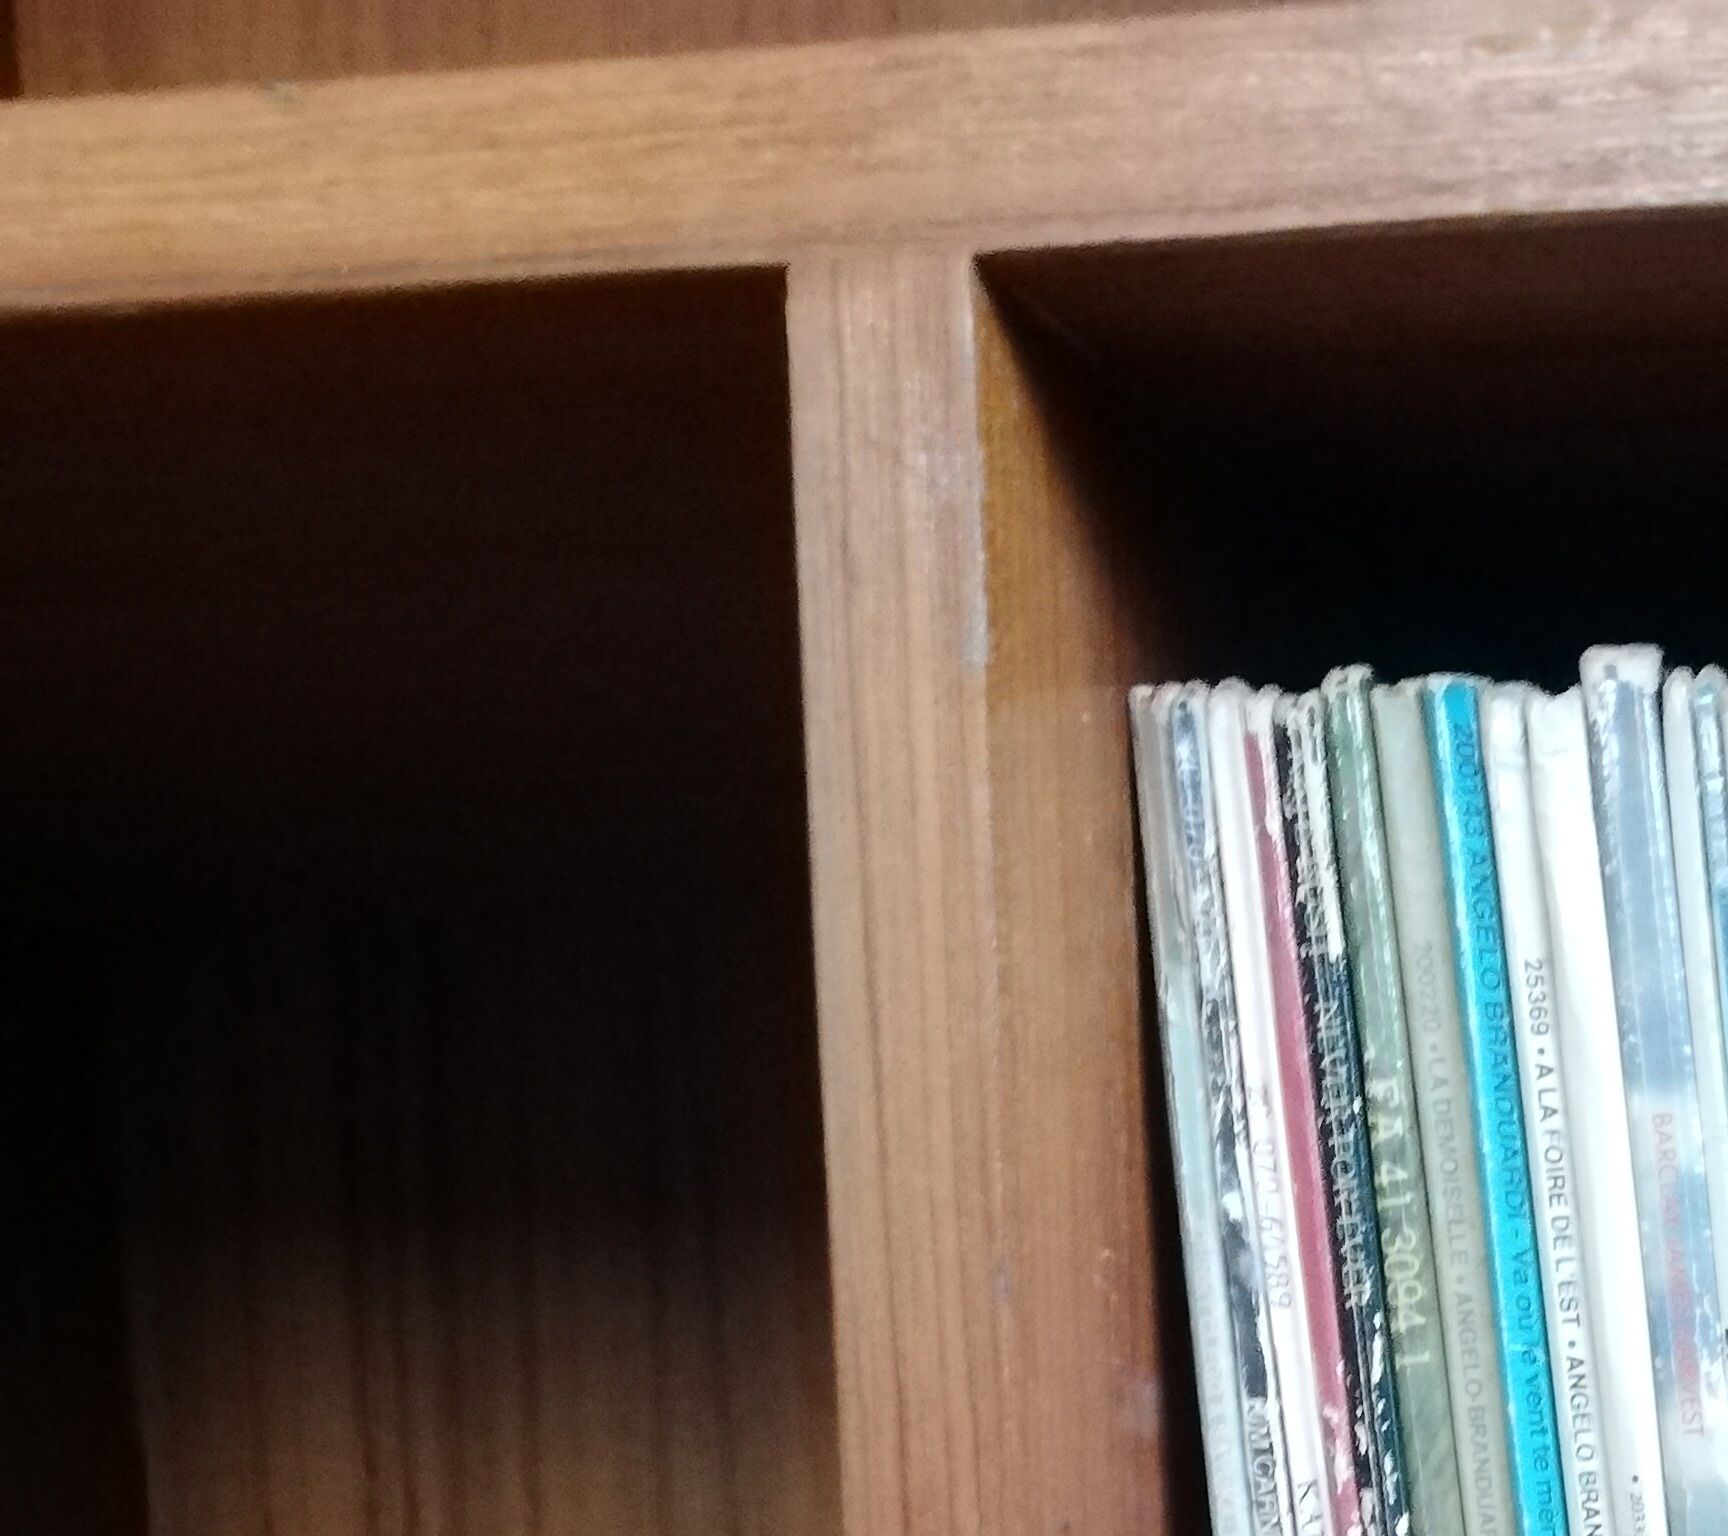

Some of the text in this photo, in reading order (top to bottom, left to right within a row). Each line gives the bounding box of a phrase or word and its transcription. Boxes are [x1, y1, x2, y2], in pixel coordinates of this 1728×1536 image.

[1463, 848, 1503, 992] ANGELO
[1520, 957, 1549, 1036] 25369
[1426, 1058, 1450, 1094] LA
[1532, 1062, 1554, 1081] A
[1535, 1087, 1559, 1124] LA
[1481, 1000, 1528, 1221] BRANDUARDI
[1431, 1099, 1470, 1265] DEMOISELLE
[1539, 1129, 1568, 1209] FOIRE
[1508, 1251, 1535, 1286] Va
[1548, 1215, 1572, 1252] DE
[1380, 1228, 1427, 1333] 3094
[1552, 1256, 1581, 1328] L'EST
[1649, 1112, 1706, 1438] BARCLAY JAMES HARVEST
[1522, 1373, 1549, 1435] vent
[1563, 1355, 1595, 1462] ANGELO
[1530, 1444, 1553, 1472] te
